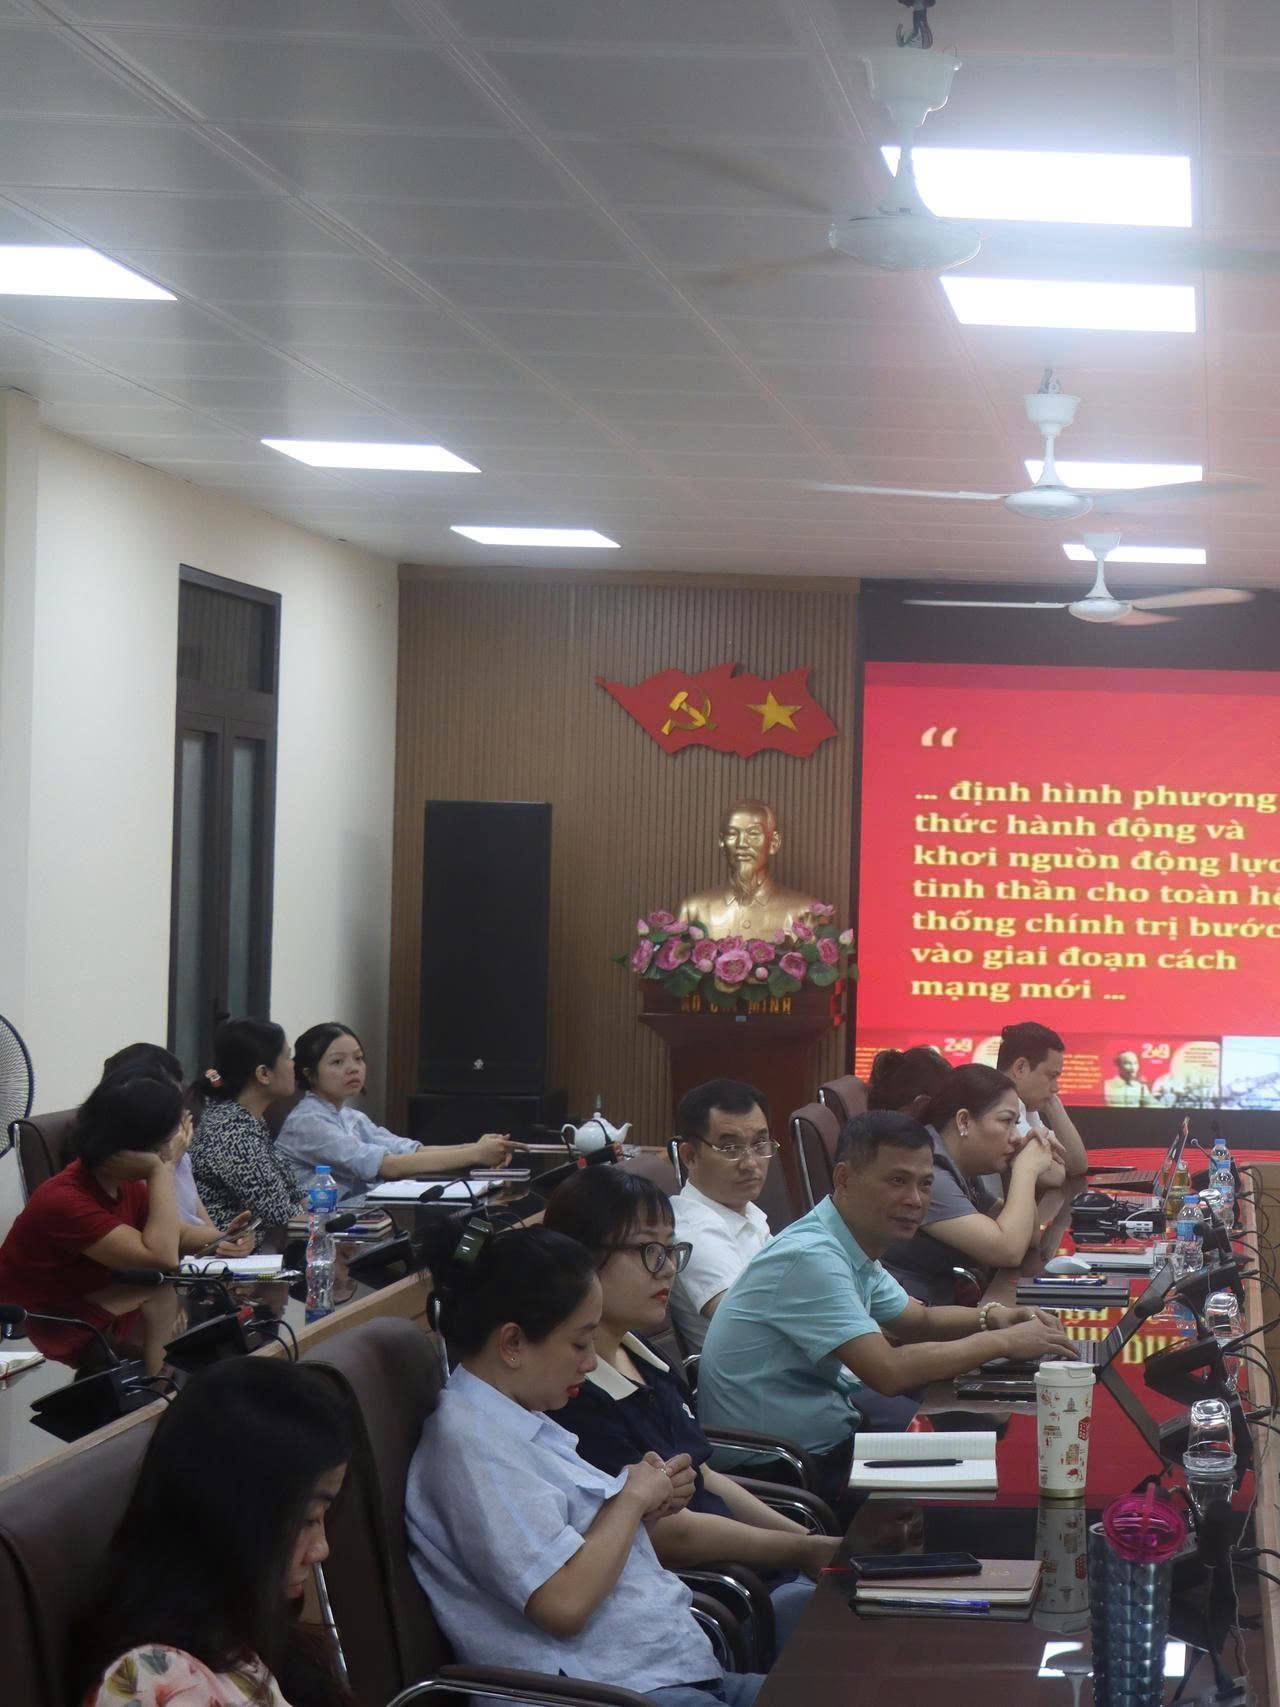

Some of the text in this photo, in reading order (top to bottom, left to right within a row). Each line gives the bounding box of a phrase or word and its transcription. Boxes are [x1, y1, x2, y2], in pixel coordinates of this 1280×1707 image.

[950, 781, 1029, 805] định
[1042, 782, 1121, 804] hình
[1134, 785, 1277, 813] phương
[915, 813, 1245, 843] thức hành động và
[914, 845, 997, 866] khơi
[1009, 847, 1119, 872] nguồn
[1131, 851, 1219, 876] động
[914, 878, 984, 899] tinh
[996, 879, 1075, 901] thần
[1087, 882, 1149, 902] cho
[1160, 884, 1237, 905] toàn
[912, 909, 1015, 936] thống
[1025, 913, 1124, 935] chính
[1136, 917, 1178, 940] trị
[912, 944, 1236, 971] vào giai đoạn cách
[911, 977, 1010, 1002] mạng
[1020, 979, 1091, 999] mới
